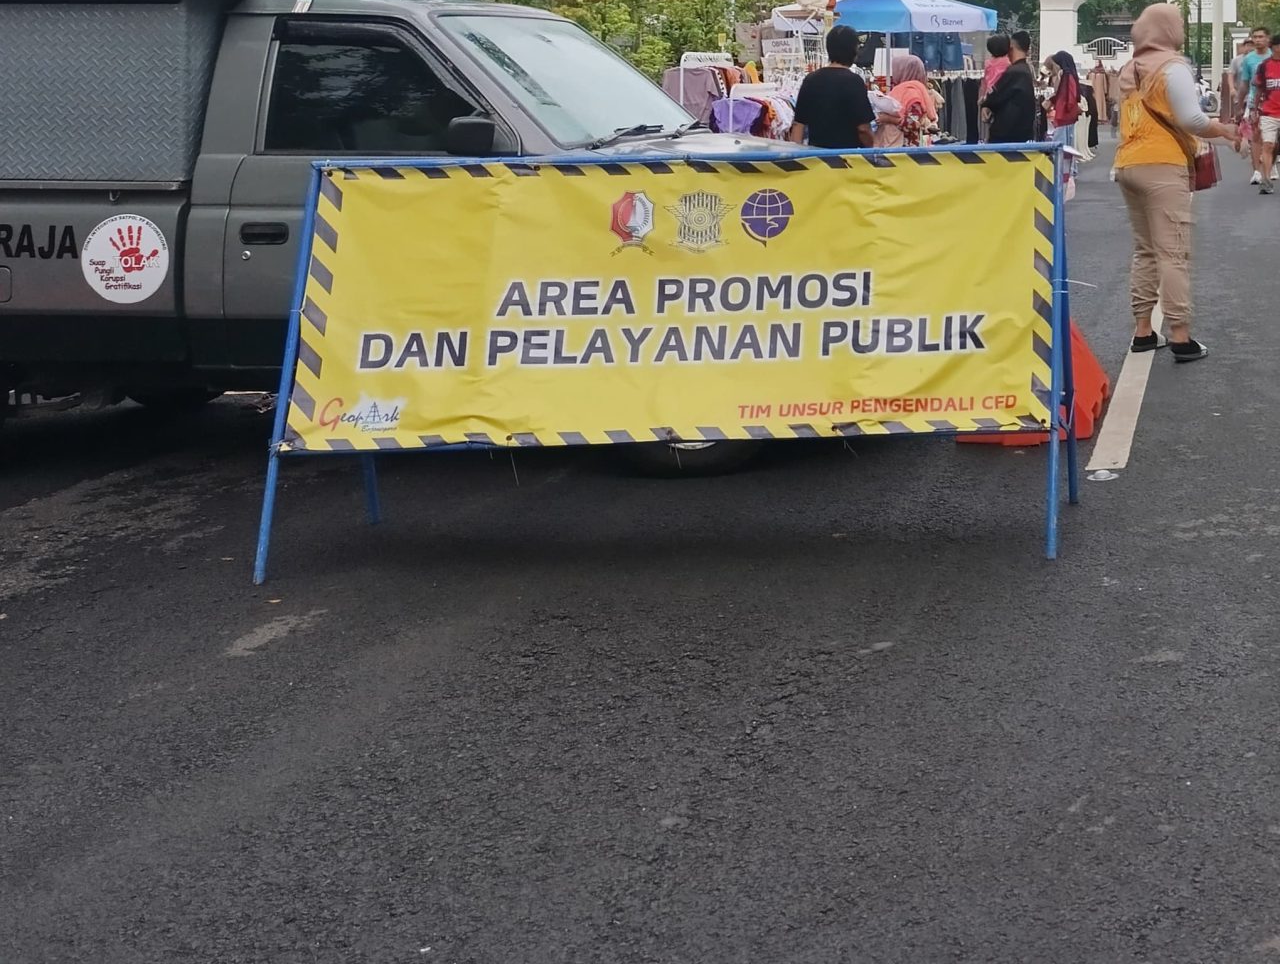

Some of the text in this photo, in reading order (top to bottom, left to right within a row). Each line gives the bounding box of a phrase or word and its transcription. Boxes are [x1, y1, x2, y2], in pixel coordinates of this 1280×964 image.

[89, 258, 106, 267] Suap
[112, 256, 160, 268] TOLAK
[94, 267, 115, 276] Pungli
[100, 275, 126, 284] Korupsi
[104, 282, 143, 291] Gratifikasi
[496, 271, 871, 316] AREA PROMOSI
[359, 314, 986, 369] DAN PELAYANAN PUBLIK
[737, 394, 1018, 419] TIM UNSUR PENGENDALI CFD
